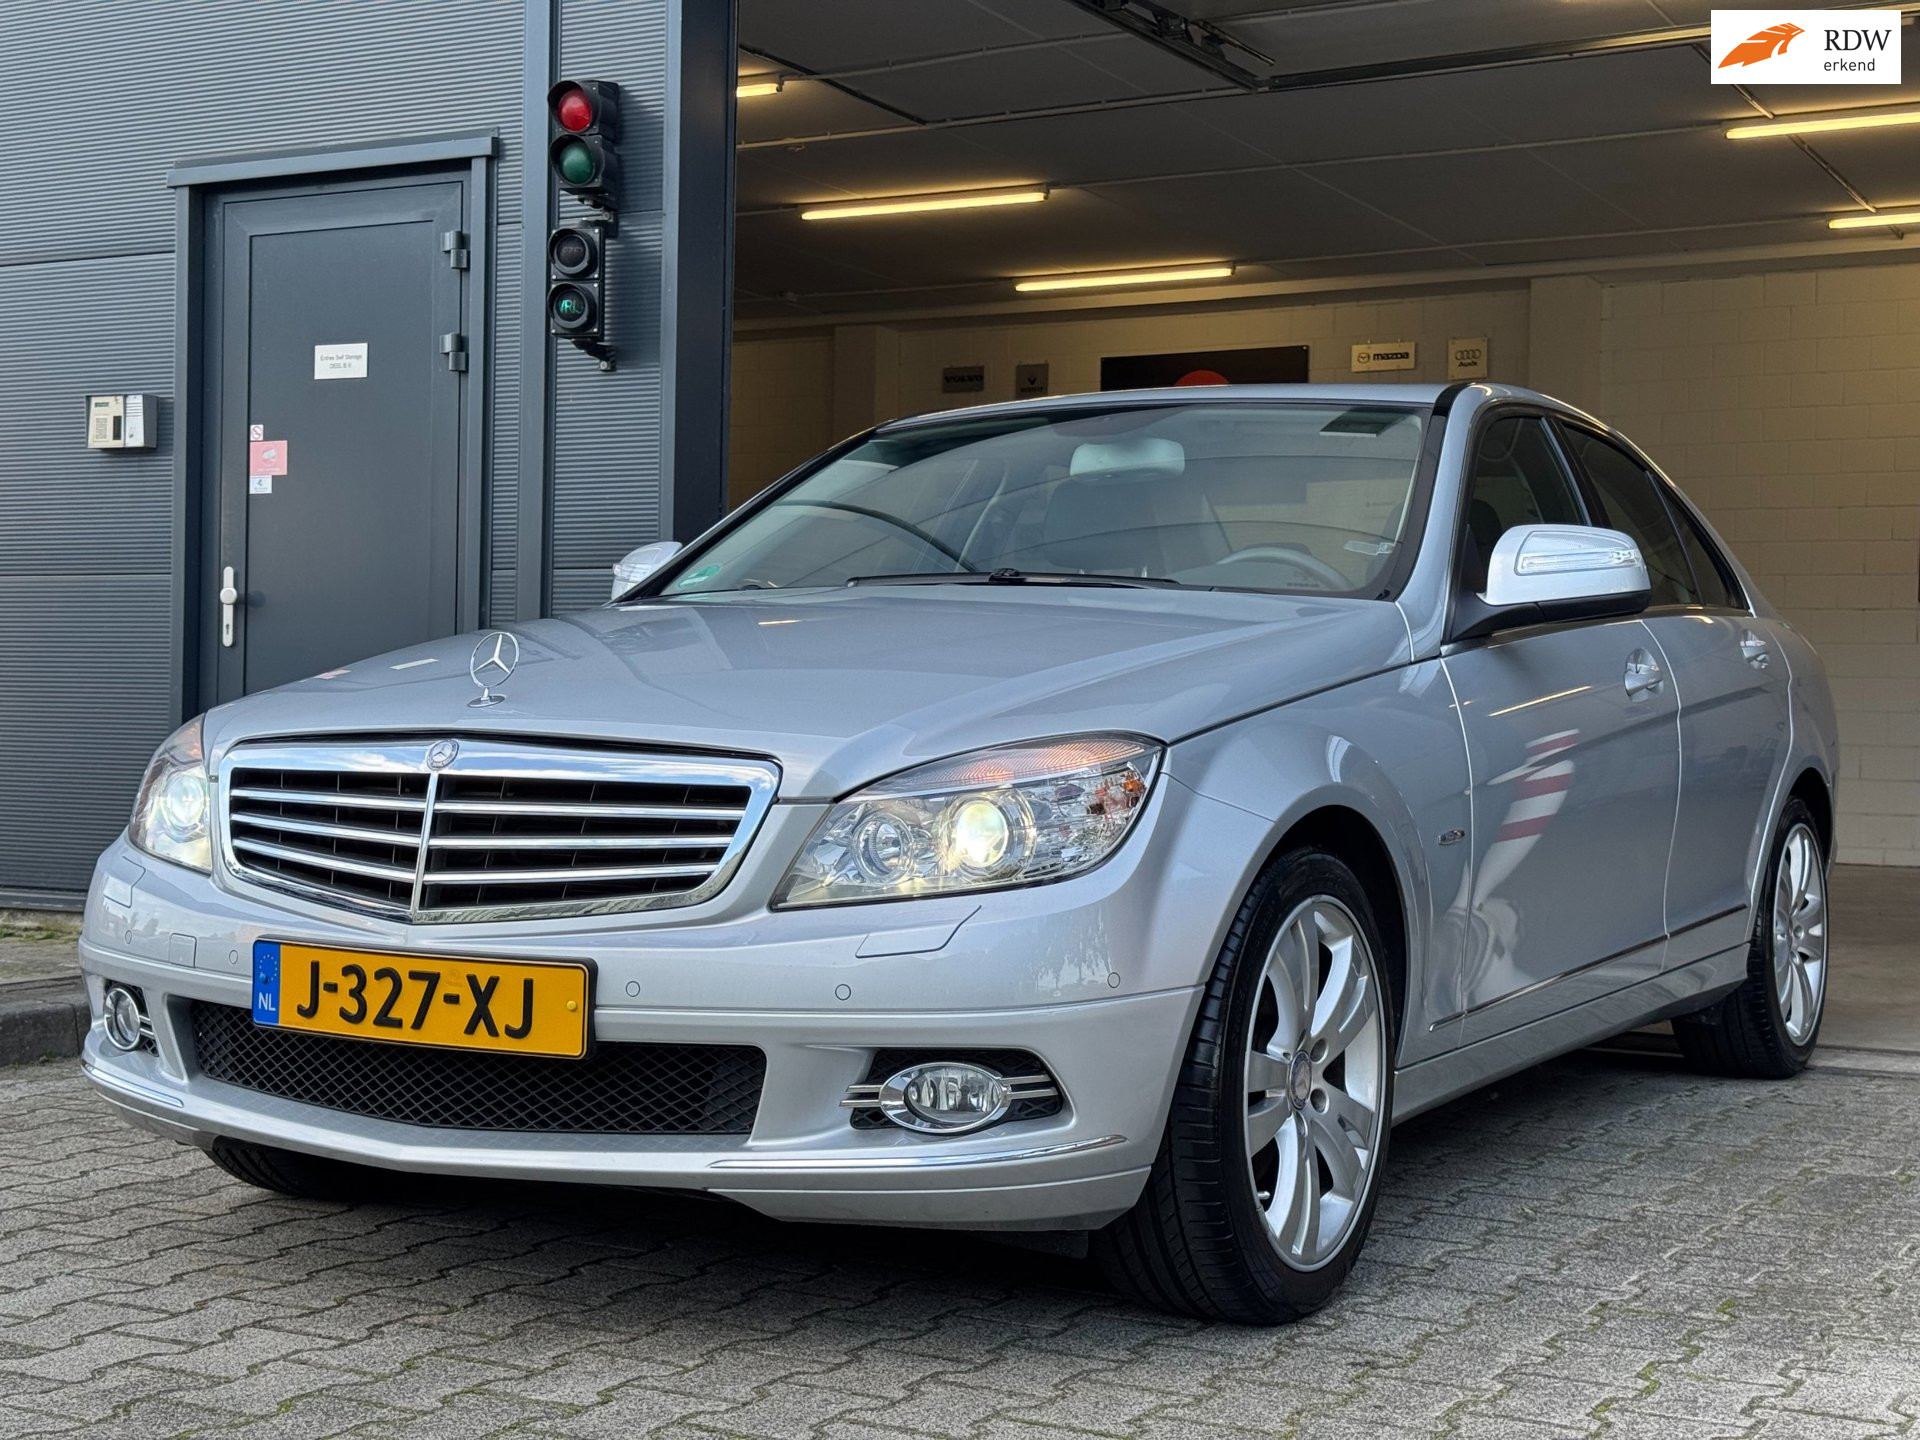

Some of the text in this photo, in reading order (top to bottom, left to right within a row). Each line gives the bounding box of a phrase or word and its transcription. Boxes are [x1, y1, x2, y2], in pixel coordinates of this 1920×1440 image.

[1373, 352, 1409, 361] mazda
[944, 375, 984, 383] VOLVO
[258, 992, 276, 1012] NL
[297, 960, 534, 1039] J-327-XJ
